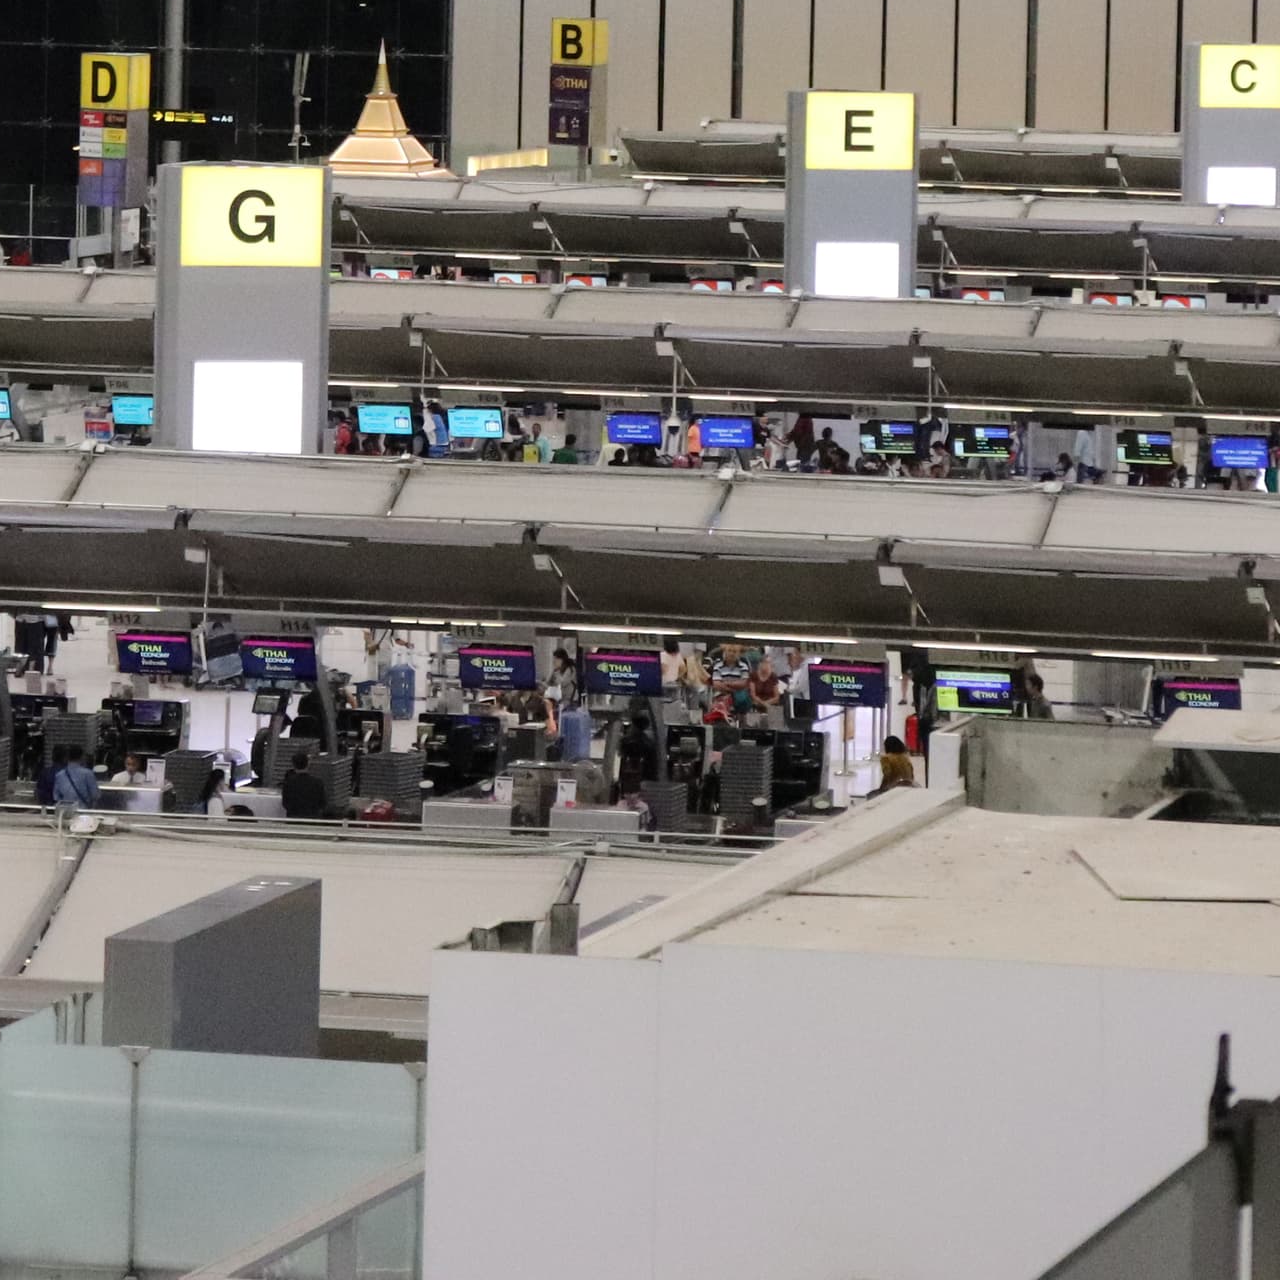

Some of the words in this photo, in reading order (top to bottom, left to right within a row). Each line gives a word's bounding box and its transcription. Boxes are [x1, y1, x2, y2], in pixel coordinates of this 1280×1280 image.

[561, 24, 583, 60] B
[1230, 59, 1257, 93] C
[91, 61, 117, 103] D
[565, 78, 588, 89] THAI
[844, 110, 874, 152] E
[228, 189, 276, 244] G
[113, 614, 141, 624] H12
[281, 620, 310, 631] H14
[457, 625, 485, 637] H15
[629, 634, 658, 644] H16
[140, 644, 162, 653] THAI
[264, 649, 287, 658] THAI
[483, 658, 506, 667] THAI
[609, 663, 632, 672] THAI
[831, 674, 856, 684] THAI
[1188, 692, 1211, 701] THAI
